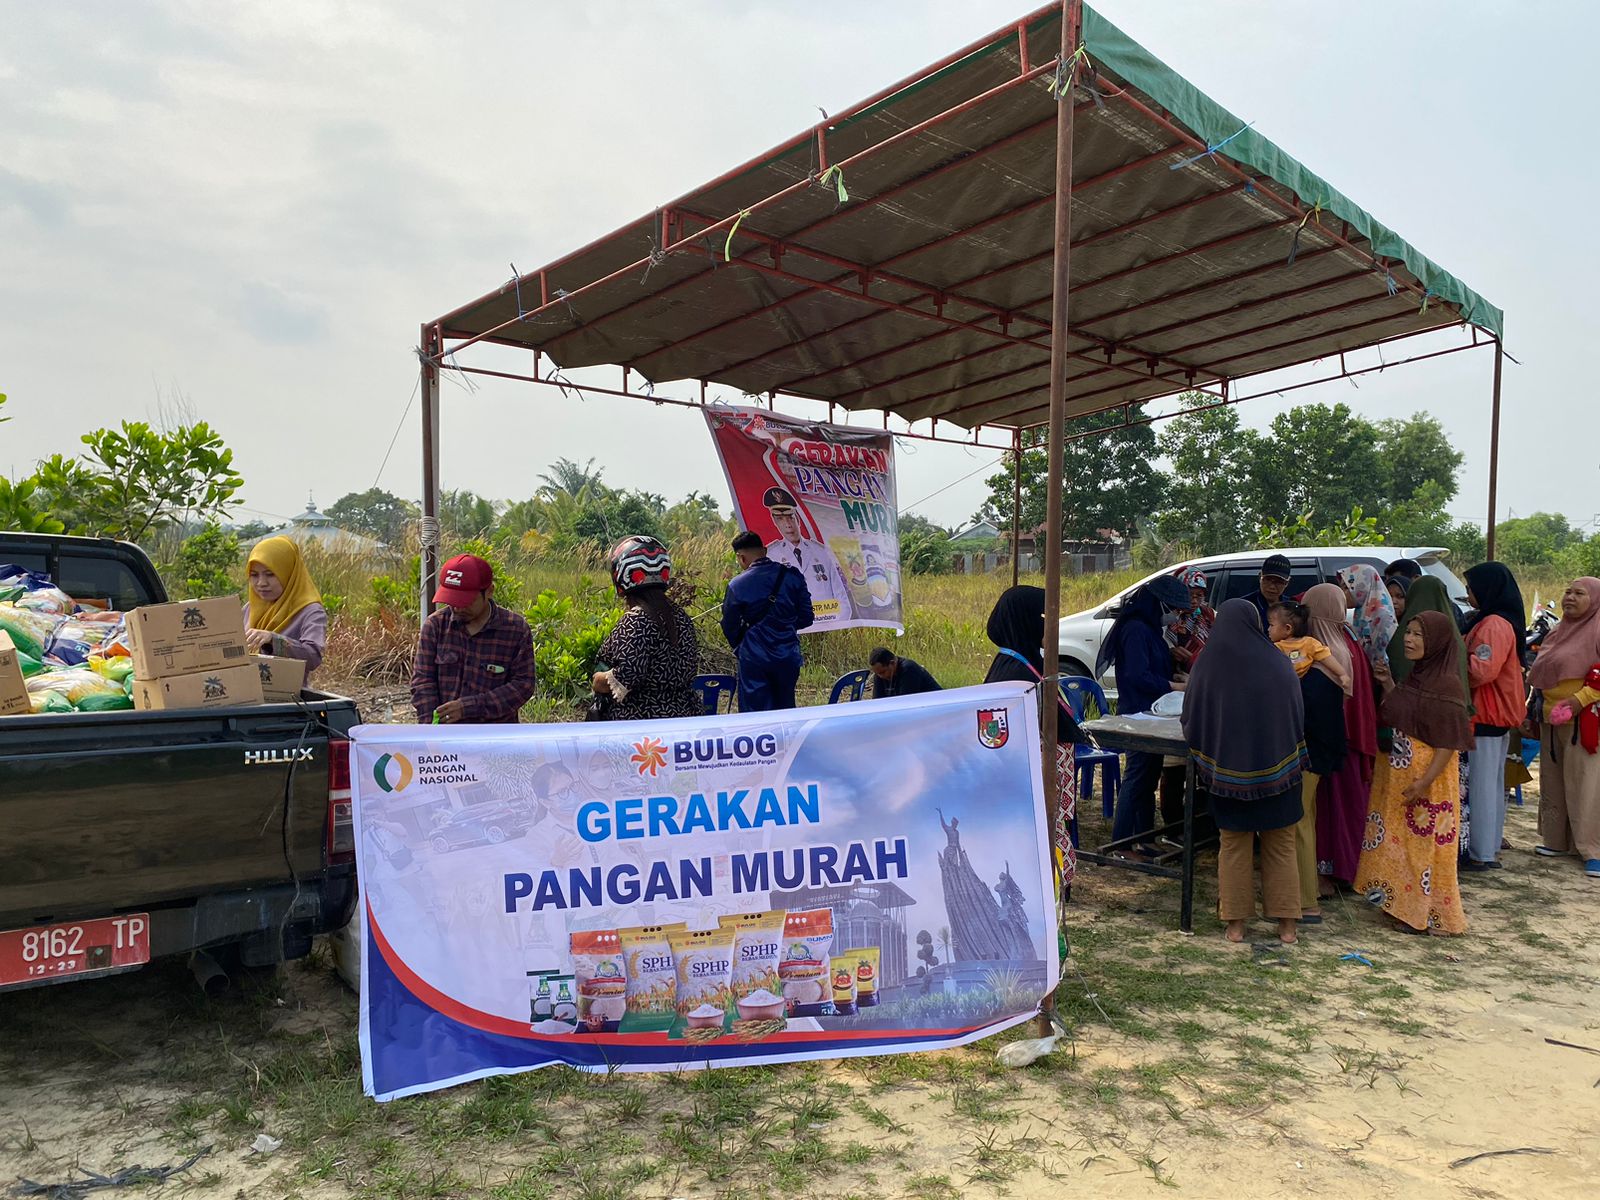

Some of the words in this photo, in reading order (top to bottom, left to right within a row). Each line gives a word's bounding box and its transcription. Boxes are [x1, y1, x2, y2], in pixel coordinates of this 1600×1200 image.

[788, 440, 889, 474] GERAKAN
[244, 747, 314, 765] HILUX
[673, 734, 777, 763] BULOG
[418, 754, 458, 764] BADAN
[419, 764, 466, 774] PANGAN
[420, 774, 478, 785] NASIONAL
[577, 784, 820, 842] GERAKAN
[504, 857, 714, 913] PANGAN
[731, 838, 909, 894] MURAH
[22, 926, 84, 962] 8162
[112, 918, 145, 949] TP
[741, 943, 778, 957] SPHP
[642, 956, 674, 969] SPH
[692, 960, 730, 973] SPHP
